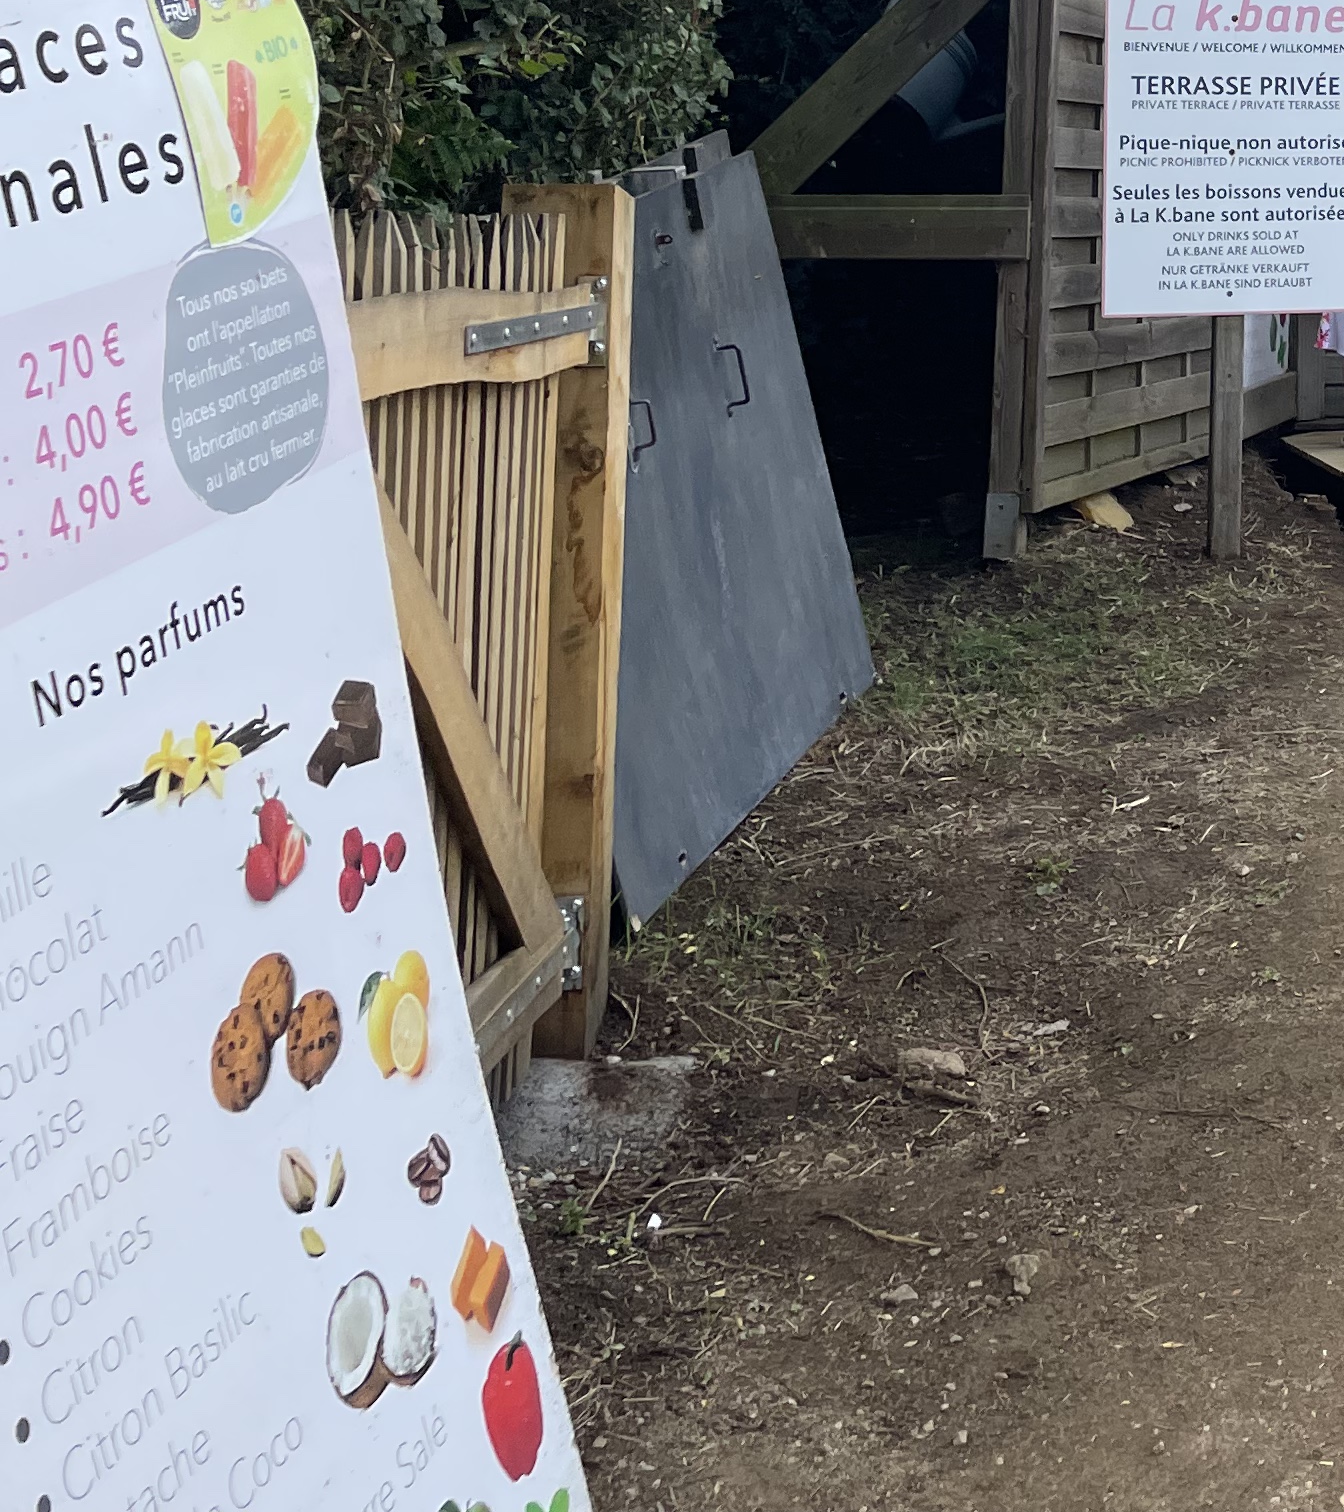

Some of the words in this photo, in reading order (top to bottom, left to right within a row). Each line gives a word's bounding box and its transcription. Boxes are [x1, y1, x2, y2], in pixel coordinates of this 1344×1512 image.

[0, 16, 144, 94] aces
[262, 35, 288, 63] BIO
[1123, 41, 1190, 53] BIENVENUE
[1201, 42, 1259, 54] WELCOME
[1130, 75, 1252, 96] TERRASSE
[1259, 71, 1341, 96] PRIVÉE
[1131, 99, 1178, 110] PRIVATE
[1180, 99, 1229, 110] TERRACE
[1240, 100, 1285, 110] PRIVATE
[1288, 100, 1341, 110] TERRASSE
[0, 123, 185, 228] nales
[1118, 134, 1231, 155] Pique-nique
[1236, 137, 1272, 150] non
[1119, 157, 1159, 167] PICNIC
[1160, 157, 1228, 167] PROHIBITED
[1238, 156, 1290, 166] PICKNICK
[1112, 184, 1170, 201] Seules
[1175, 183, 1200, 200] les
[1205, 183, 1281, 200] boissons
[1114, 207, 1125, 223] à
[1130, 207, 1150, 223] La
[1155, 206, 1215, 223] K.bane
[1220, 206, 1260, 222] sont
[1161, 265, 1187, 275] NUR
[1190, 262, 1249, 275] GETRÄNKE
[1252, 263, 1310, 274] VERKAUFT
[1166, 246, 1180, 257] LA
[1183, 246, 1224, 257] K.BANE
[1226, 245, 1248, 256] ARE
[1250, 245, 1305, 255] ALLOWED
[1172, 231, 1205, 242] ONLY
[1208, 231, 1249, 241] DRINKS
[1252, 230, 1282, 241] SOLD
[1284, 230, 1299, 240] AT
[176, 293, 211, 318] Tous
[214, 284, 239, 306] nos
[239, 266, 288, 297] sorbets
[1158, 280, 1171, 290] IN
[1174, 279, 1187, 290] LA
[1190, 279, 1231, 290] K.BANE
[1234, 278, 1262, 289] SIND
[1264, 277, 1313, 288] ERLAUBT
[187, 331, 212, 353] ont
[212, 299, 291, 345] l'appellation
[248, 337, 293, 365] Toutes
[294, 324, 317, 346] nos
[18, 333, 94, 400] 2,70
[102, 322, 125, 367] €
[171, 401, 217, 439] glaces
[218, 386, 249, 413] sont
[249, 362, 307, 406] garanties
[308, 352, 326, 373] de
[187, 418, 259, 464] fabrication
[261, 388, 324, 432] artisanale,
[35, 404, 107, 472] 4,00
[115, 391, 138, 437] €
[206, 473, 223, 493] au
[225, 456, 247, 483] lait
[248, 451, 269, 473] cru
[270, 428, 318, 464] fermier.
[50, 475, 121, 544] 4,90
[128, 460, 151, 506] €
[30, 661, 104, 728] Nos
[115, 584, 245, 696] parfums
[99, 921, 205, 1027] Amann
[2, 1112, 172, 1278] Framboise
[21, 1214, 154, 1349] Cookies
[41, 1315, 145, 1425] Citron
[62, 1387, 165, 1501] Citron
[164, 1291, 258, 1401] Basilic
[228, 1415, 304, 1510] Coco
[395, 1403, 449, 1489] Salé
